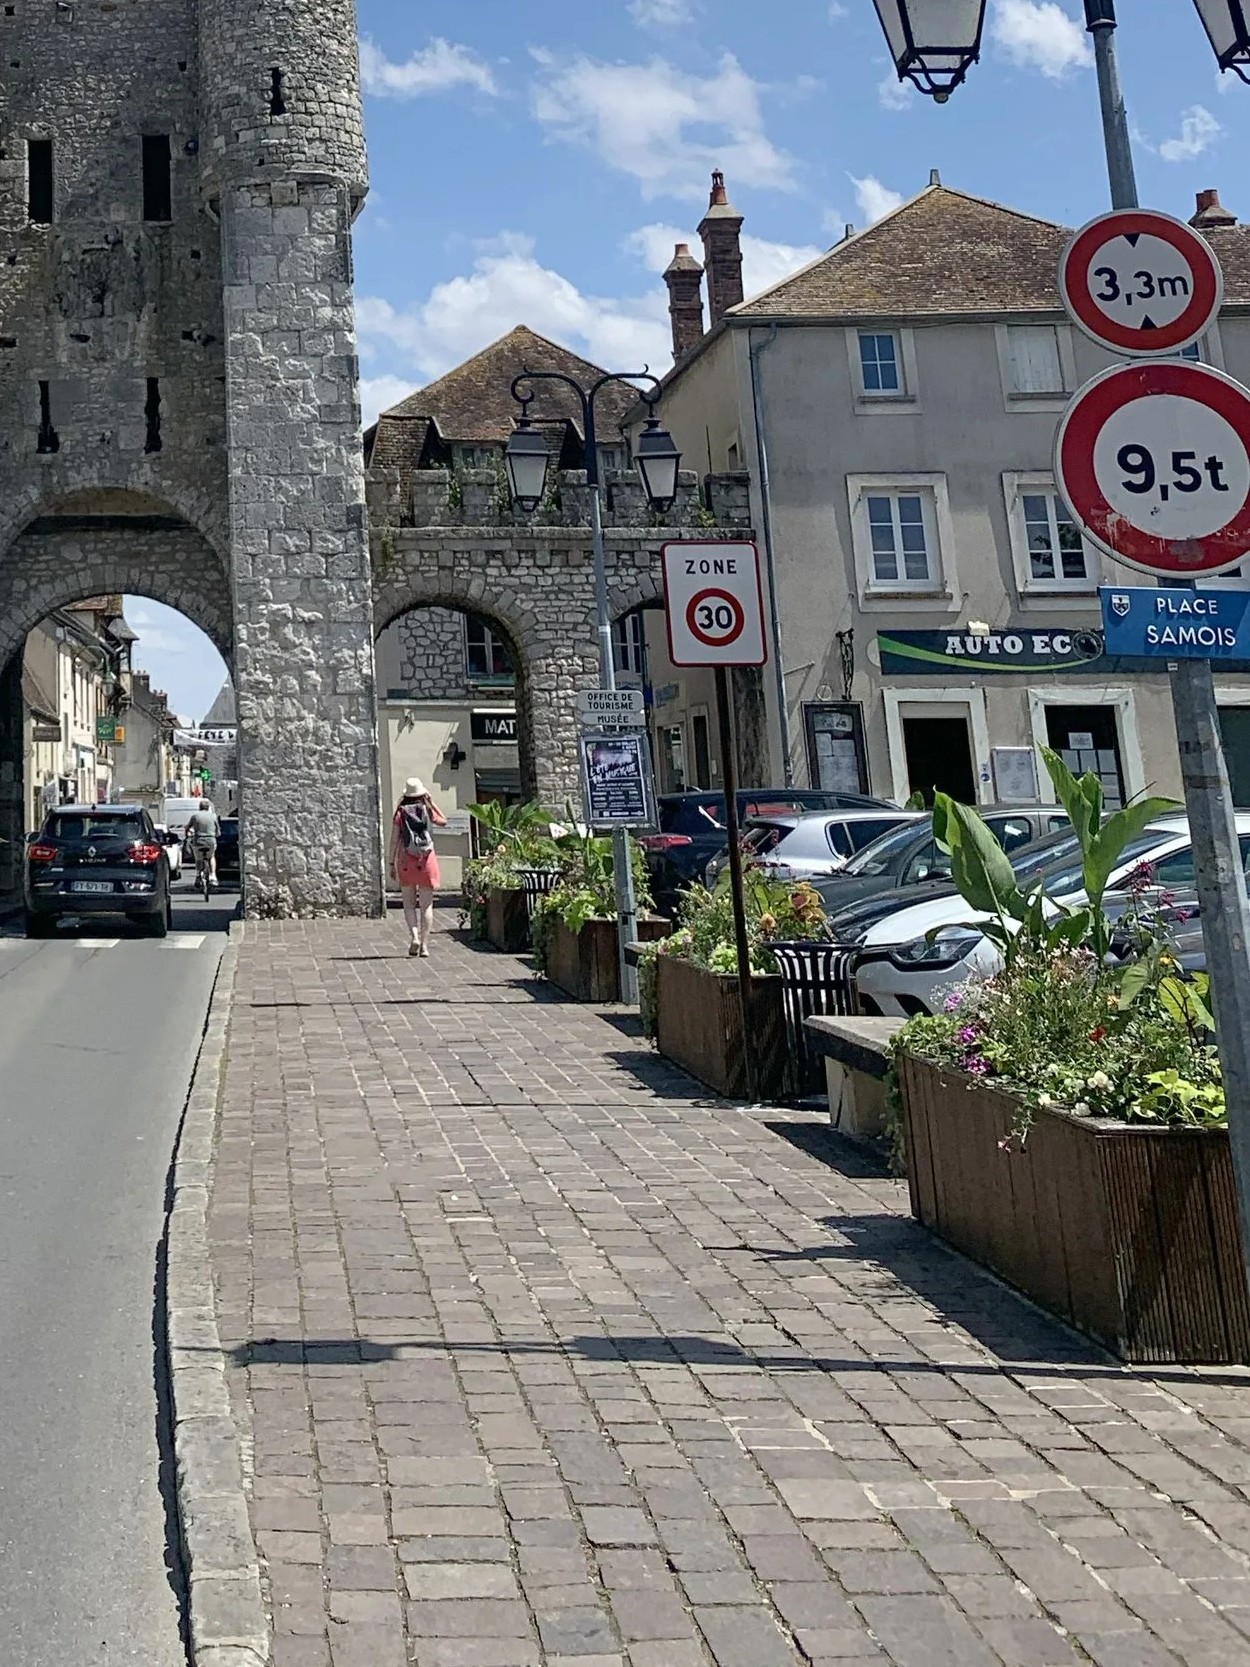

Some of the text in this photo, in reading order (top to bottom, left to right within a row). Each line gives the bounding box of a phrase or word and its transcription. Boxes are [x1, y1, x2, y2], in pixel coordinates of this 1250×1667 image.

[1094, 267, 1189, 306] 3,3m
[1117, 444, 1230, 501] 9,5t
[685, 560, 737, 574] ZONE
[1156, 598, 1218, 614] PLACE
[698, 605, 733, 629] 30
[1147, 625, 1236, 646] SAMOIS
[945, 635, 1024, 654] AUTO
[587, 693, 619, 701] OFFICE
[588, 702, 634, 710] TOURISME
[485, 719, 516, 734] MAT
[597, 713, 629, 724] MUSÉE
